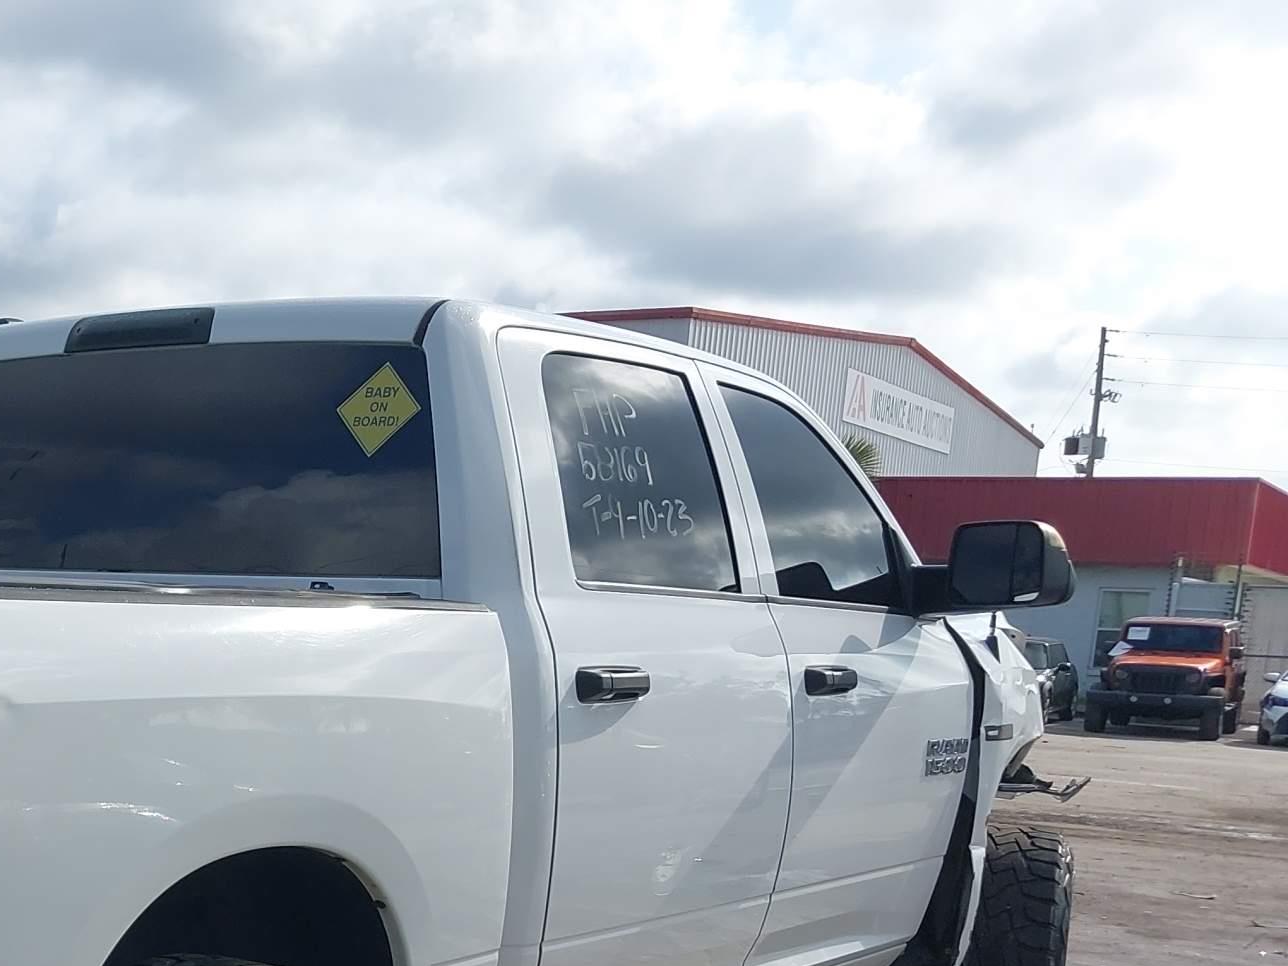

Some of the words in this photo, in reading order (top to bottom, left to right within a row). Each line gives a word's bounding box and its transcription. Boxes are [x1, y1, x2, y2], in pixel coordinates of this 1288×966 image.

[365, 387, 400, 398] BABY
[369, 402, 388, 412] ON
[353, 416, 399, 427] BOARD!
[926, 738, 969, 757] RAM
[925, 757, 967, 777] 1500
